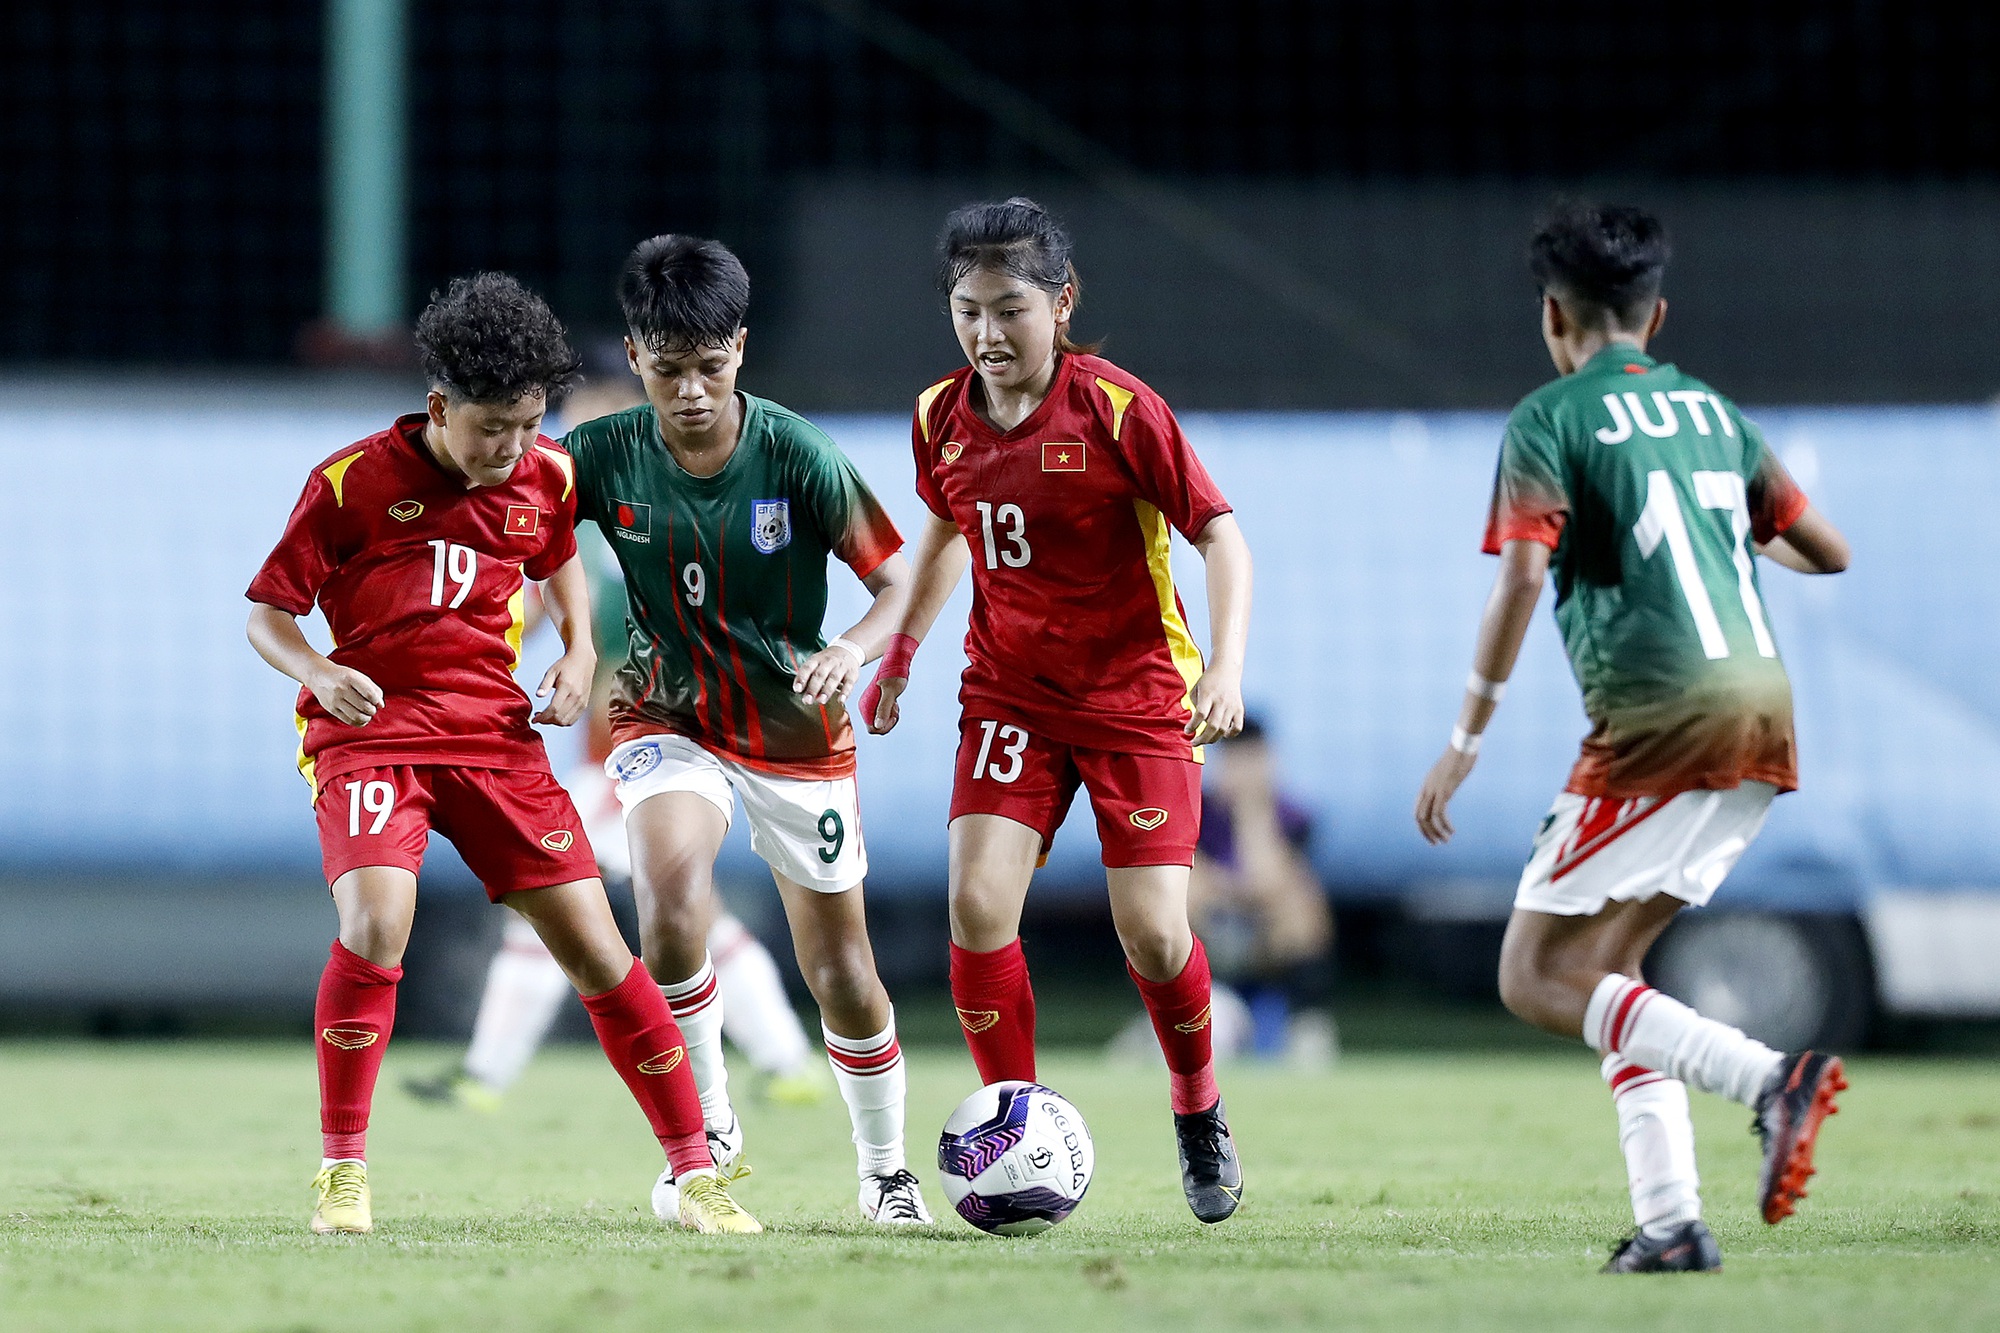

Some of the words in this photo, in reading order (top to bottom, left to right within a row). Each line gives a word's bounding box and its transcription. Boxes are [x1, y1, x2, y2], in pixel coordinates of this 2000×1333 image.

[1595, 390, 1733, 445] JUTI
[977, 501, 1031, 570] 13
[1632, 469, 1776, 660] 17
[427, 539, 477, 610] 19
[683, 562, 706, 607] 9
[973, 720, 1029, 783] 13
[345, 780, 394, 836] 19
[817, 808, 843, 863] 9
